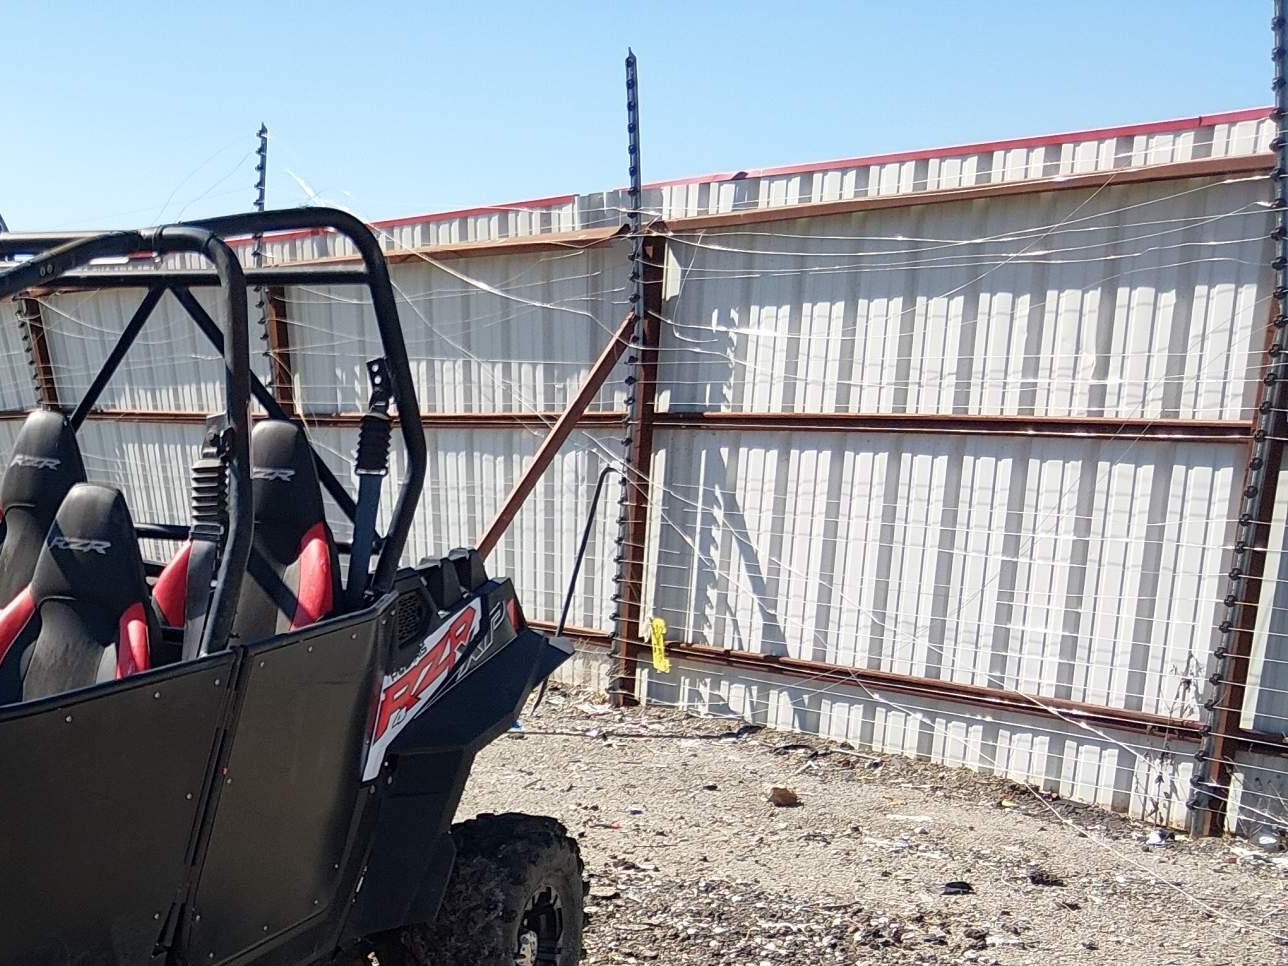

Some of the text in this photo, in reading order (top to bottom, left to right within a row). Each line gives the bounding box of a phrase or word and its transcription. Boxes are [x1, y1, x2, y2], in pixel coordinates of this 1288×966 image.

[252, 467, 296, 482] ZR
[49, 536, 112, 555] RZR
[373, 605, 478, 746] RZR
